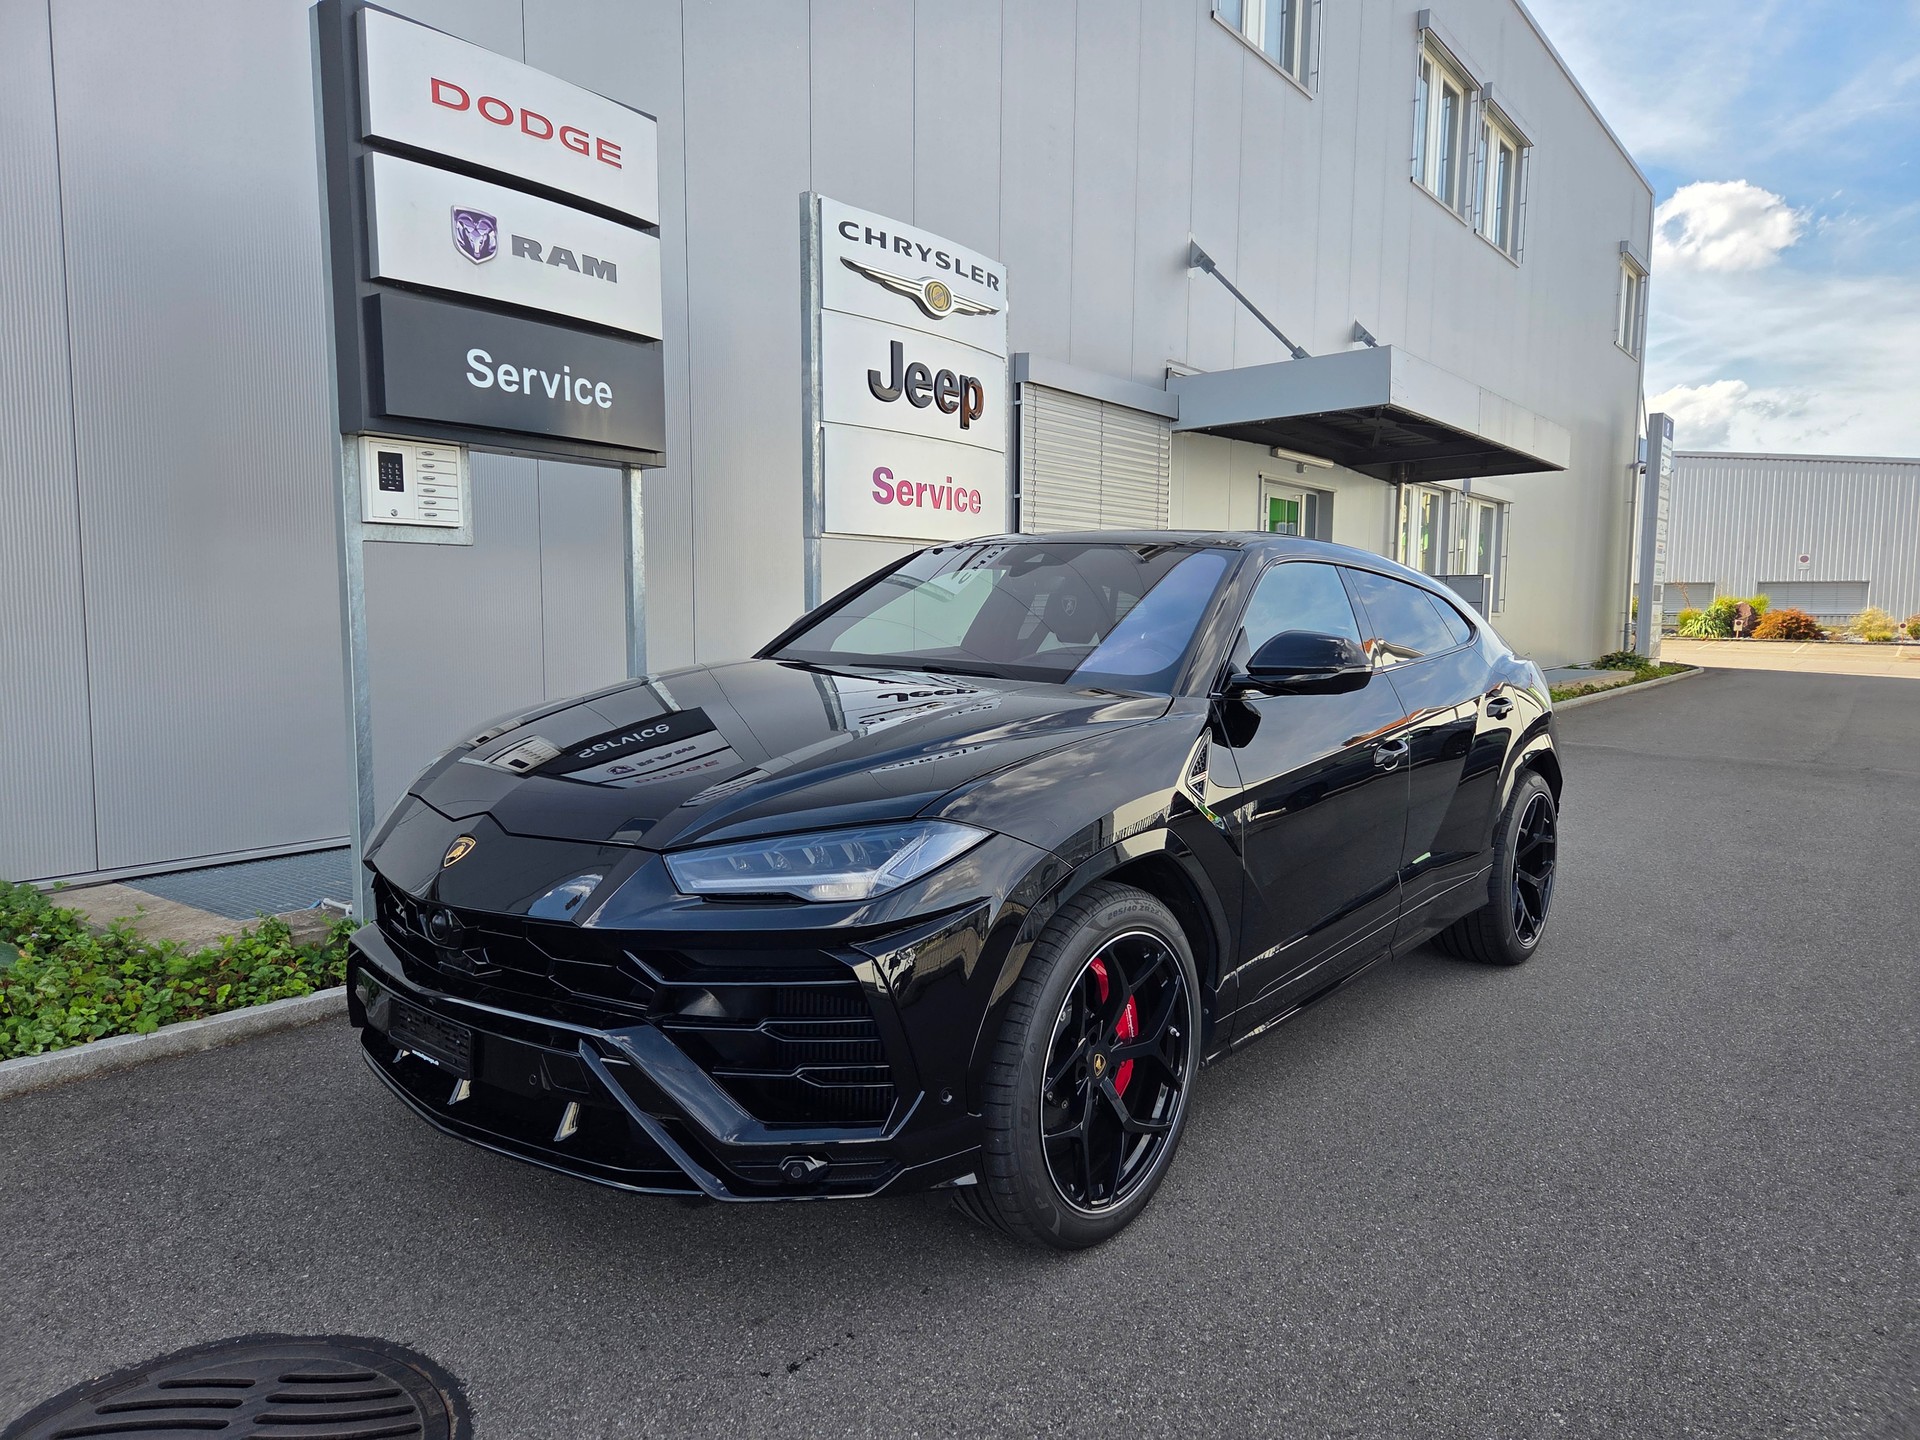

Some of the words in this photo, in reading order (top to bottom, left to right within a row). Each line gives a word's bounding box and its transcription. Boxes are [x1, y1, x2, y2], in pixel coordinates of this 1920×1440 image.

[430, 76, 623, 170] DODGE
[511, 234, 618, 284] RAM
[838, 220, 1000, 292] CHRYSLER
[466, 348, 613, 409] Service
[867, 339, 985, 430] Jeep
[871, 466, 982, 515] Service
